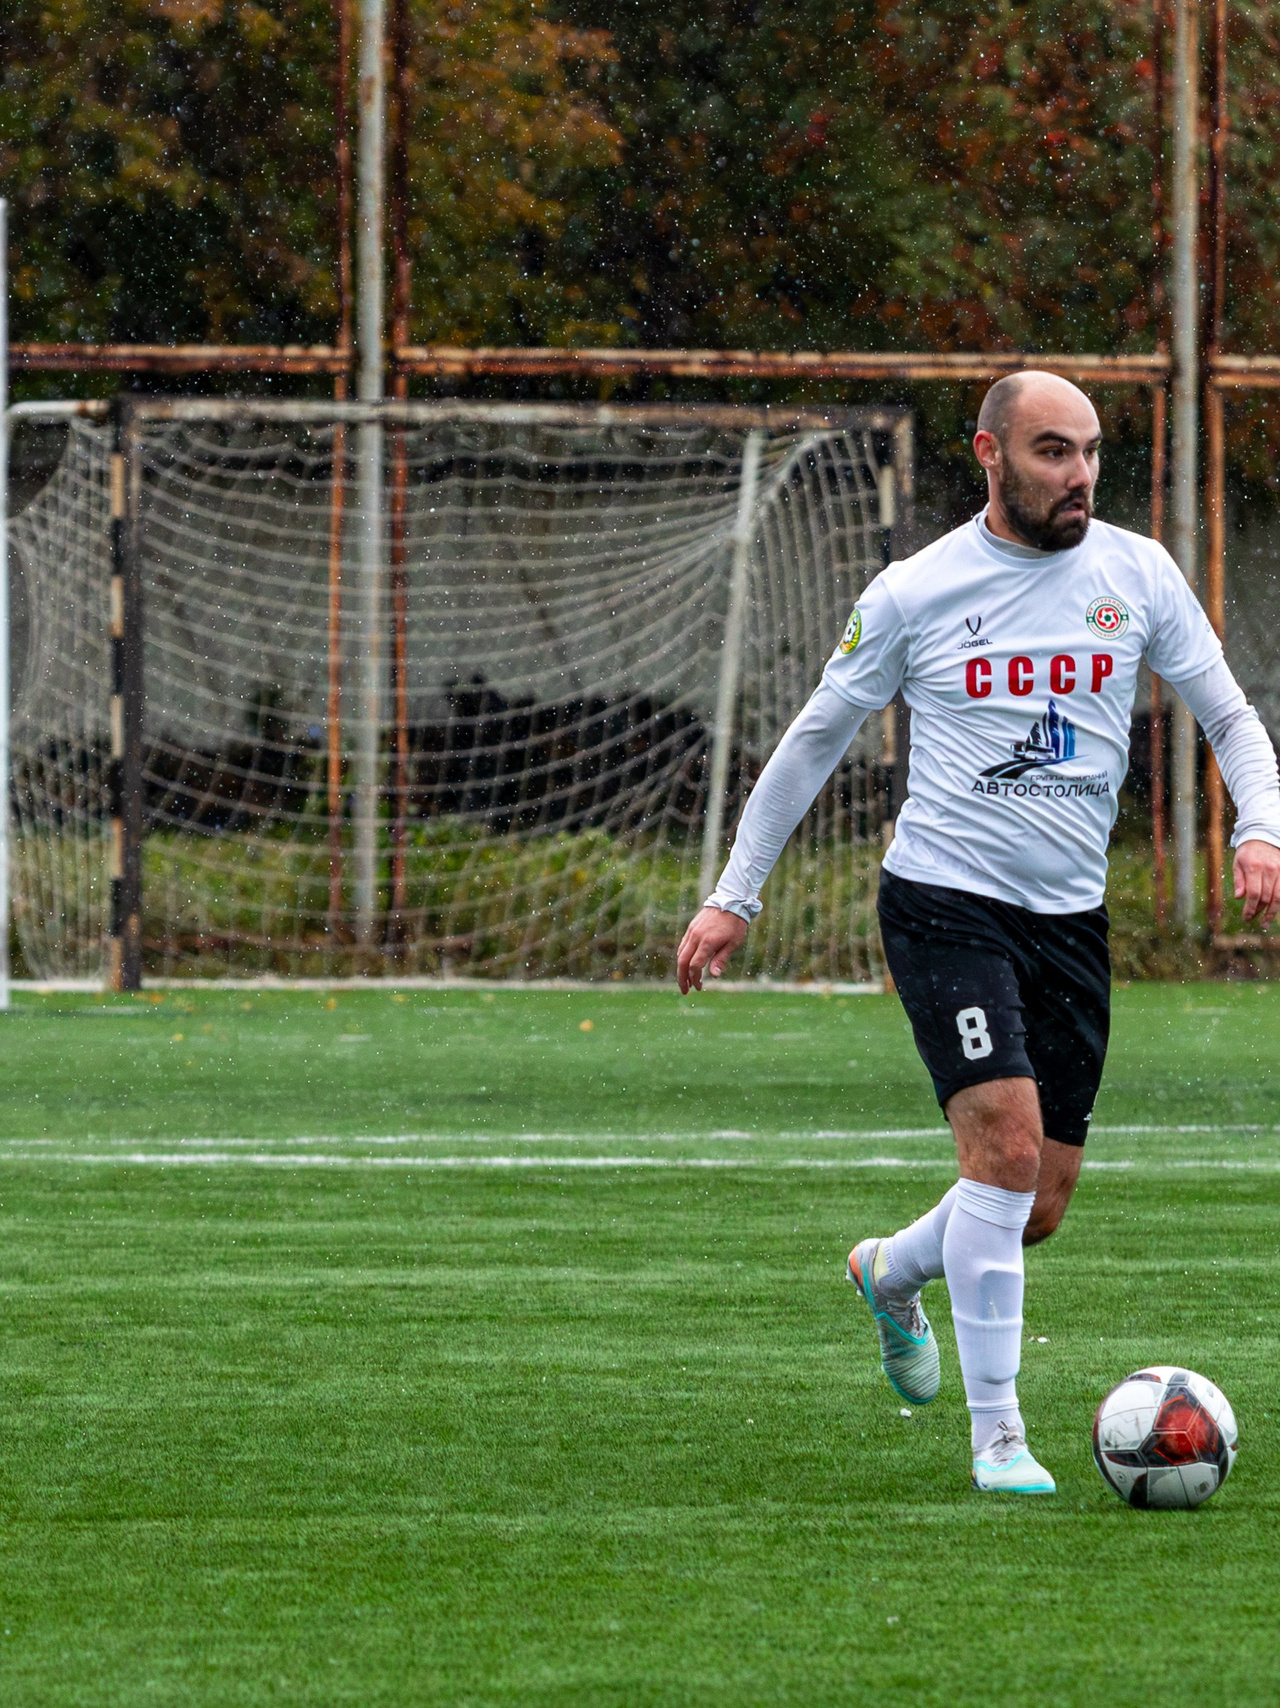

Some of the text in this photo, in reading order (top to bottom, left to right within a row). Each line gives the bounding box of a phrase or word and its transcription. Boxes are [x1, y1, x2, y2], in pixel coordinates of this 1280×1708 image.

[957, 638, 993, 650] JÖGEL
[965, 653, 1113, 699] СССР
[971, 780, 1110, 798] АВТОСТОЛИЦА
[956, 1006, 993, 1061] 8
